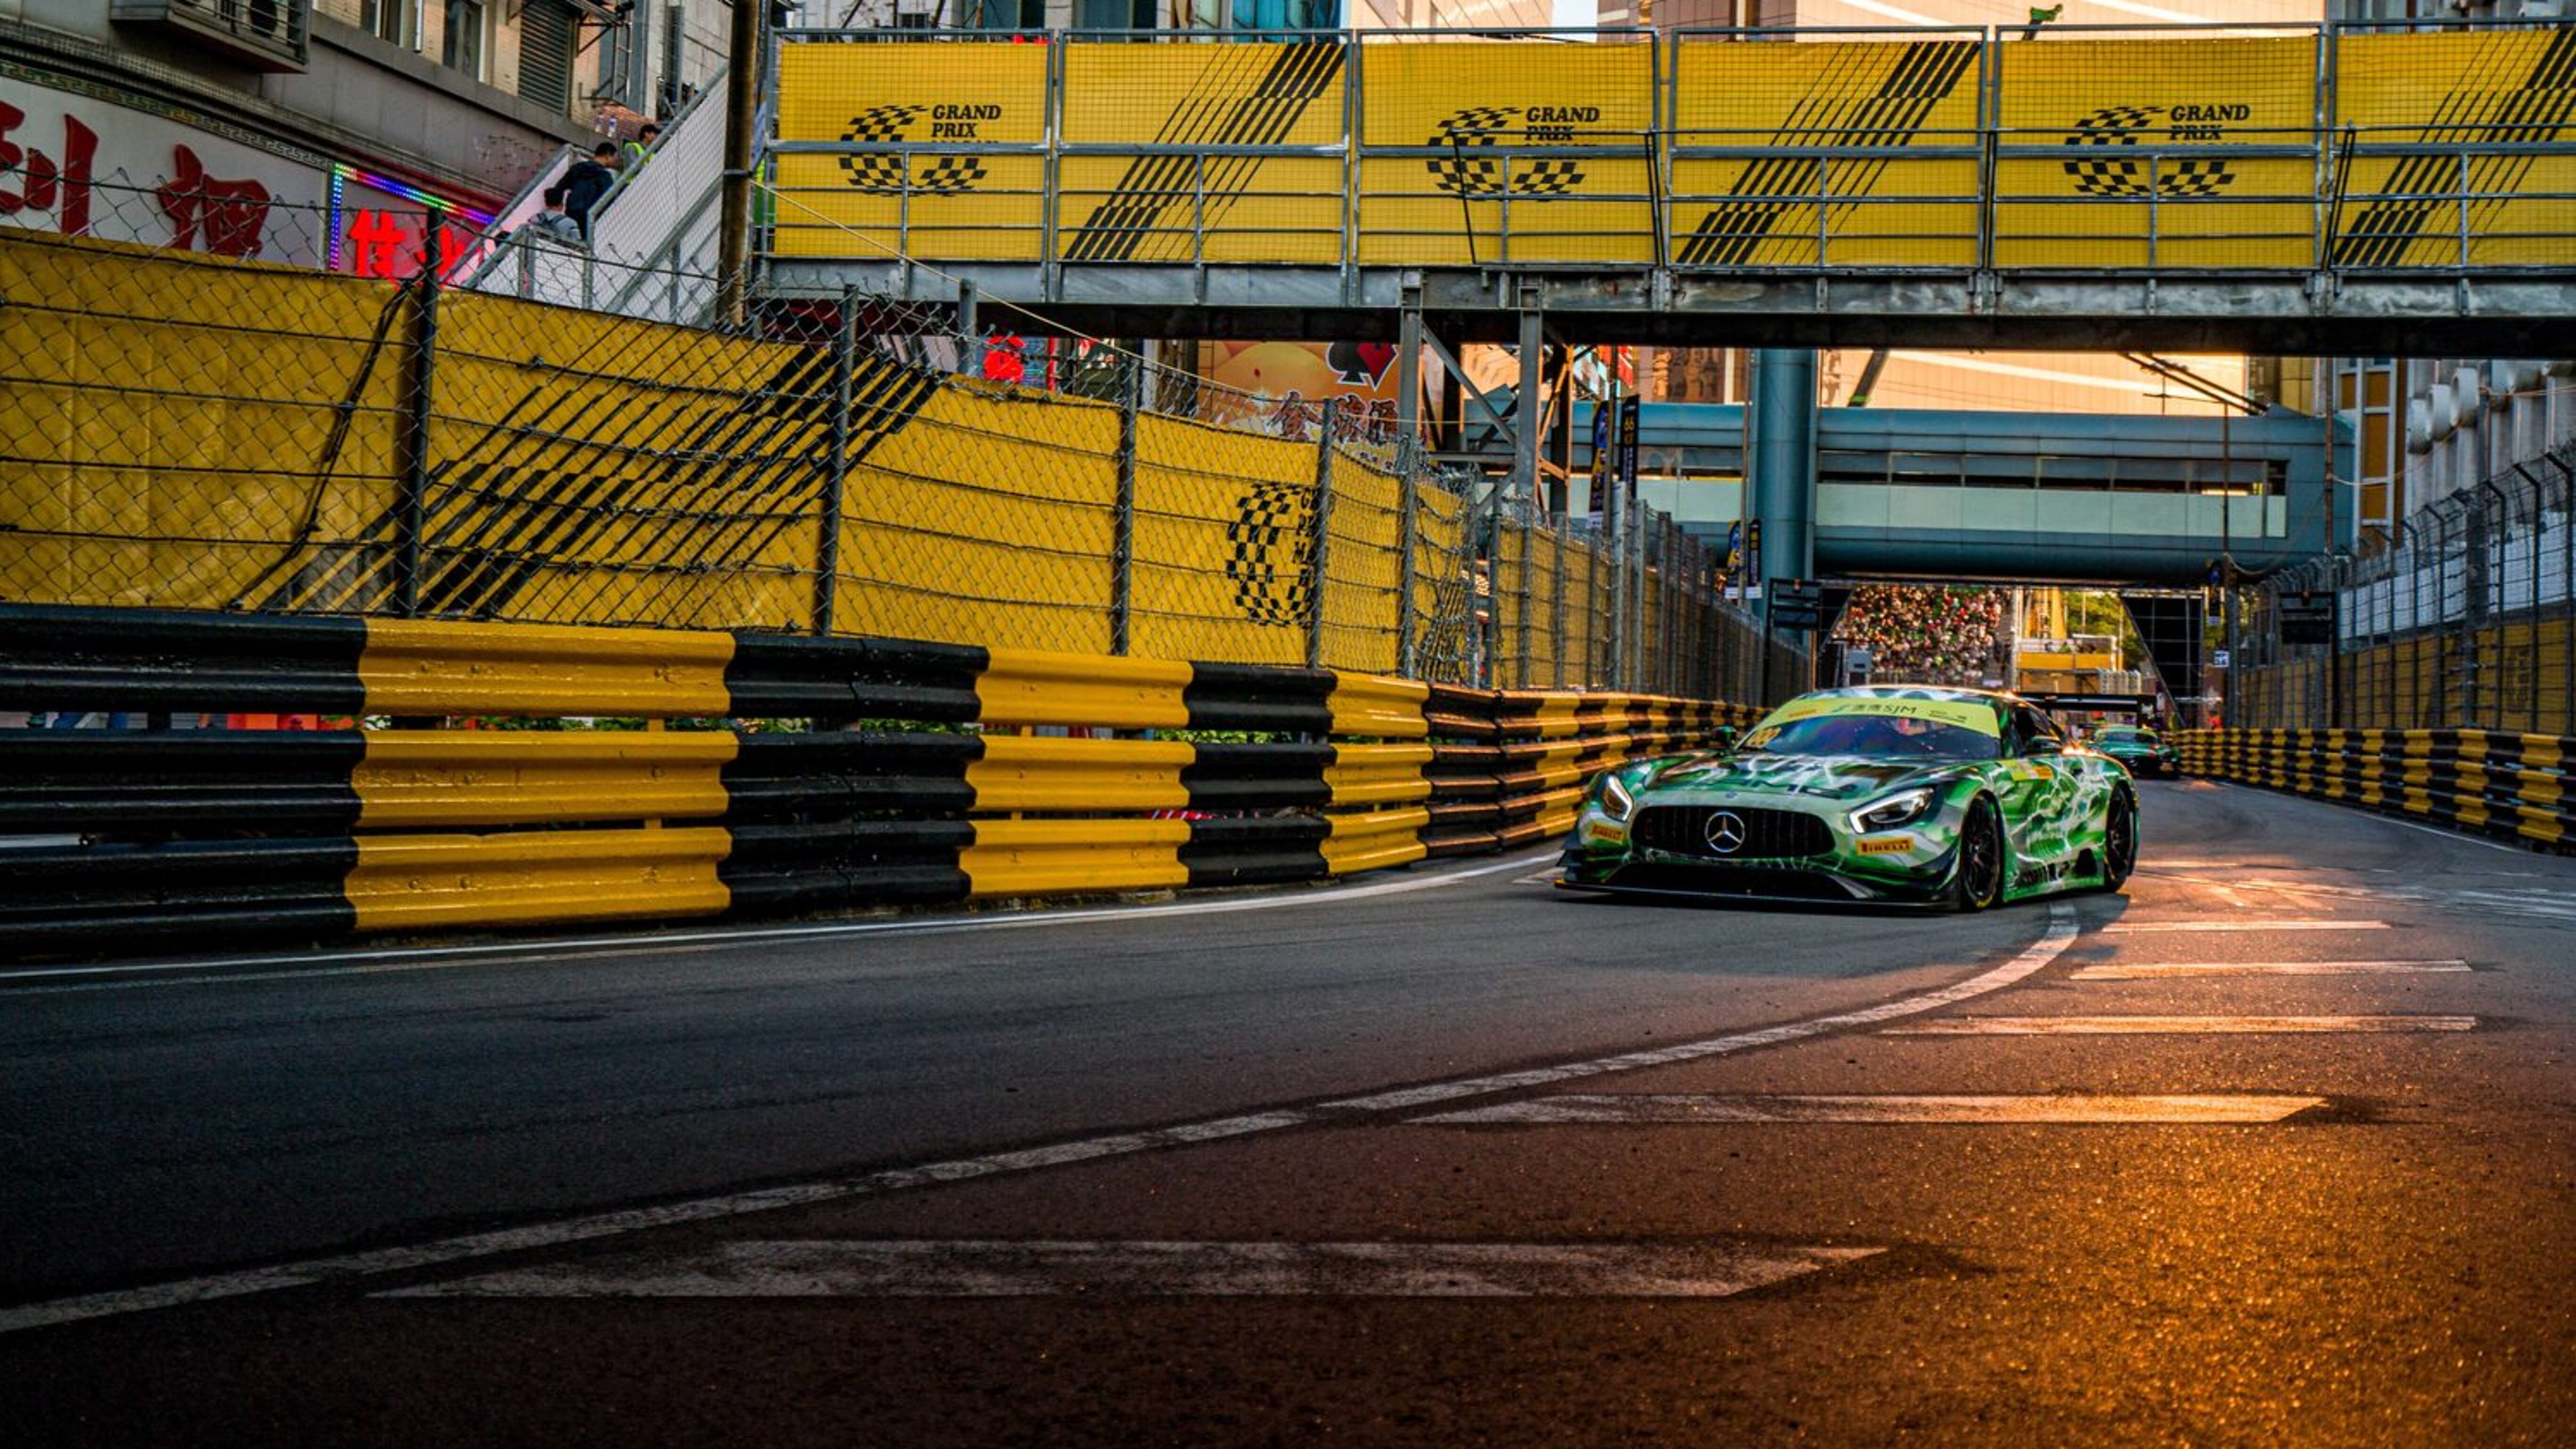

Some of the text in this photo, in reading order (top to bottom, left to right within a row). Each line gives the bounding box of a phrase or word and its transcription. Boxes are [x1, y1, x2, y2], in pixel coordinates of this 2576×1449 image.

[932, 105, 1002, 120] GRAND
[1526, 107, 1600, 123] GRAND
[2170, 105, 2250, 121] GRAND
[930, 123, 978, 138] PRIX
[1524, 125, 1575, 141] PRIX
[2169, 125, 2222, 140] PRIX
[1861, 840, 1910, 853] PIRELLI
